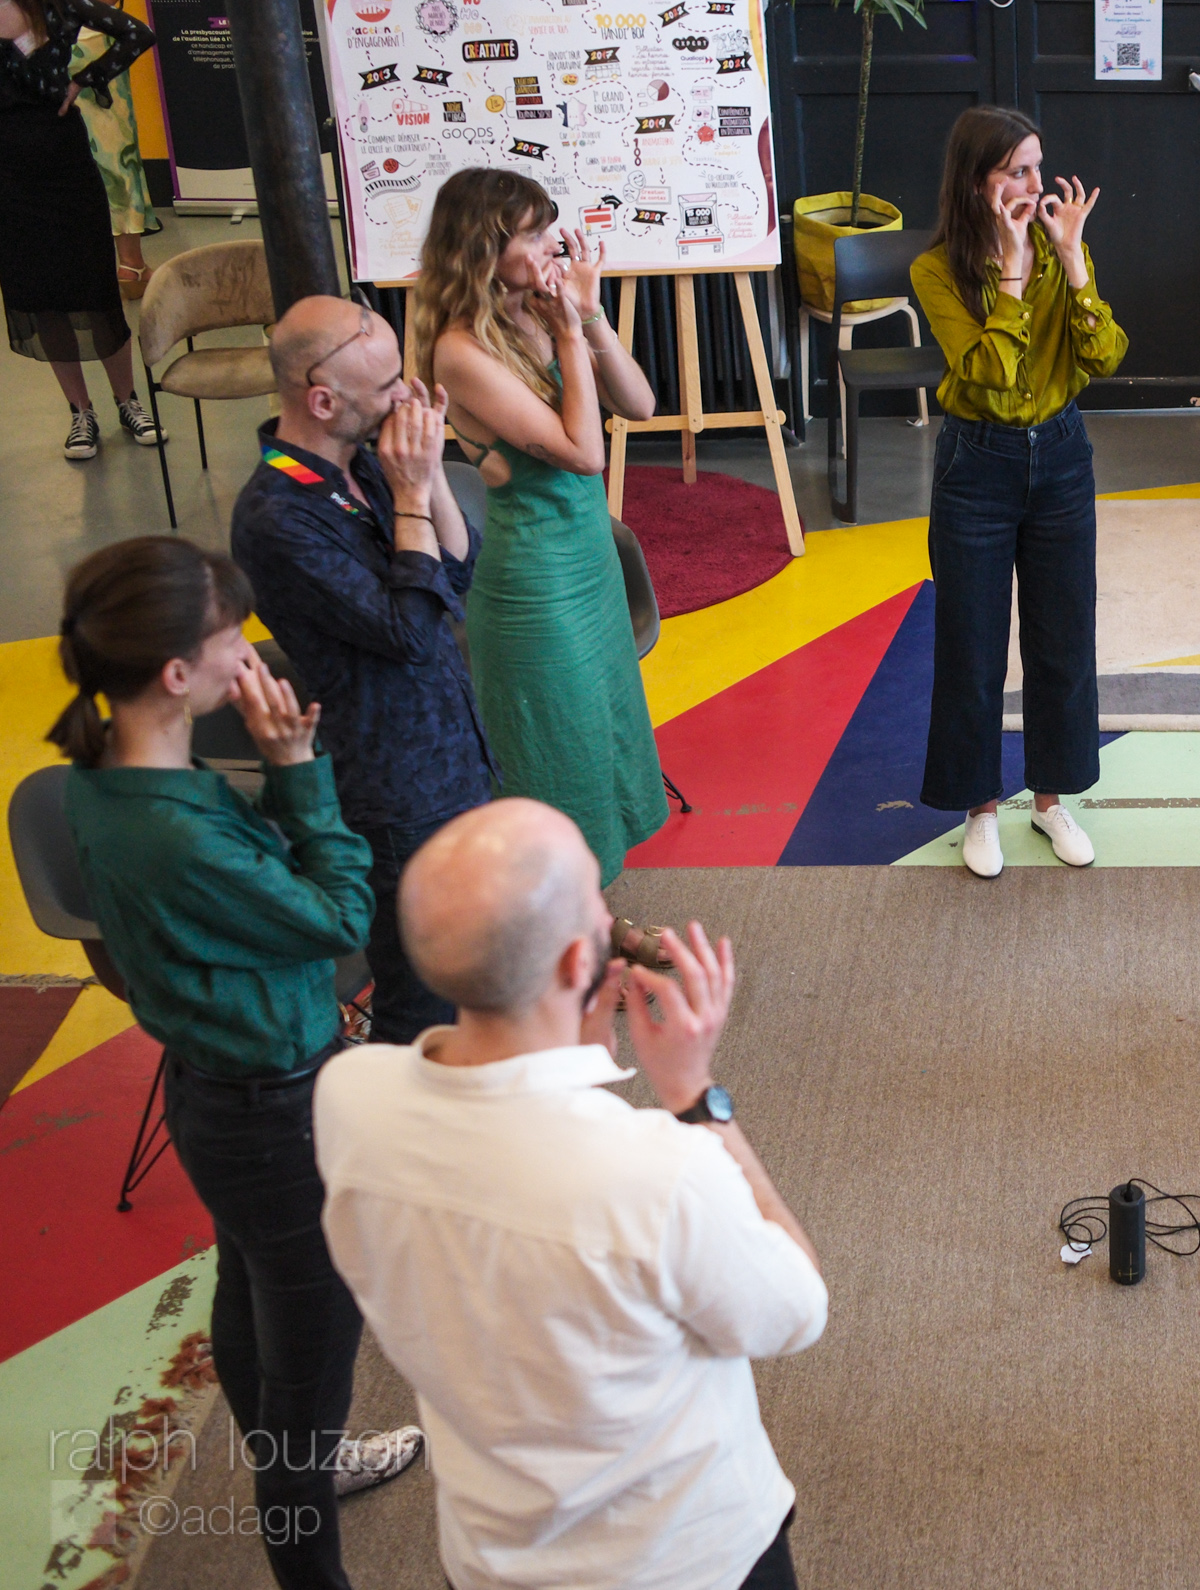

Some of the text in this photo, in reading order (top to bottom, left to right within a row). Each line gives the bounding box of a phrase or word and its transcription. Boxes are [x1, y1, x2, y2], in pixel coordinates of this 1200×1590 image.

[664, 5, 685, 22] 2022
[711, 3, 731, 13] 2023
[594, 13, 646, 28] 10 000
[464, 40, 516, 60] CRÉATIVITÉ
[590, 50, 614, 61] 2017
[722, 57, 746, 70] 2021
[366, 68, 391, 84] 2013
[420, 69, 443, 82] 2014
[396, 112, 430, 126] VISION
[642, 118, 666, 129] 2019
[442, 127, 494, 141] GOODS
[516, 142, 540, 155] 2015
[638, 210, 661, 222] 2020
[695, 208, 711, 217] 000
